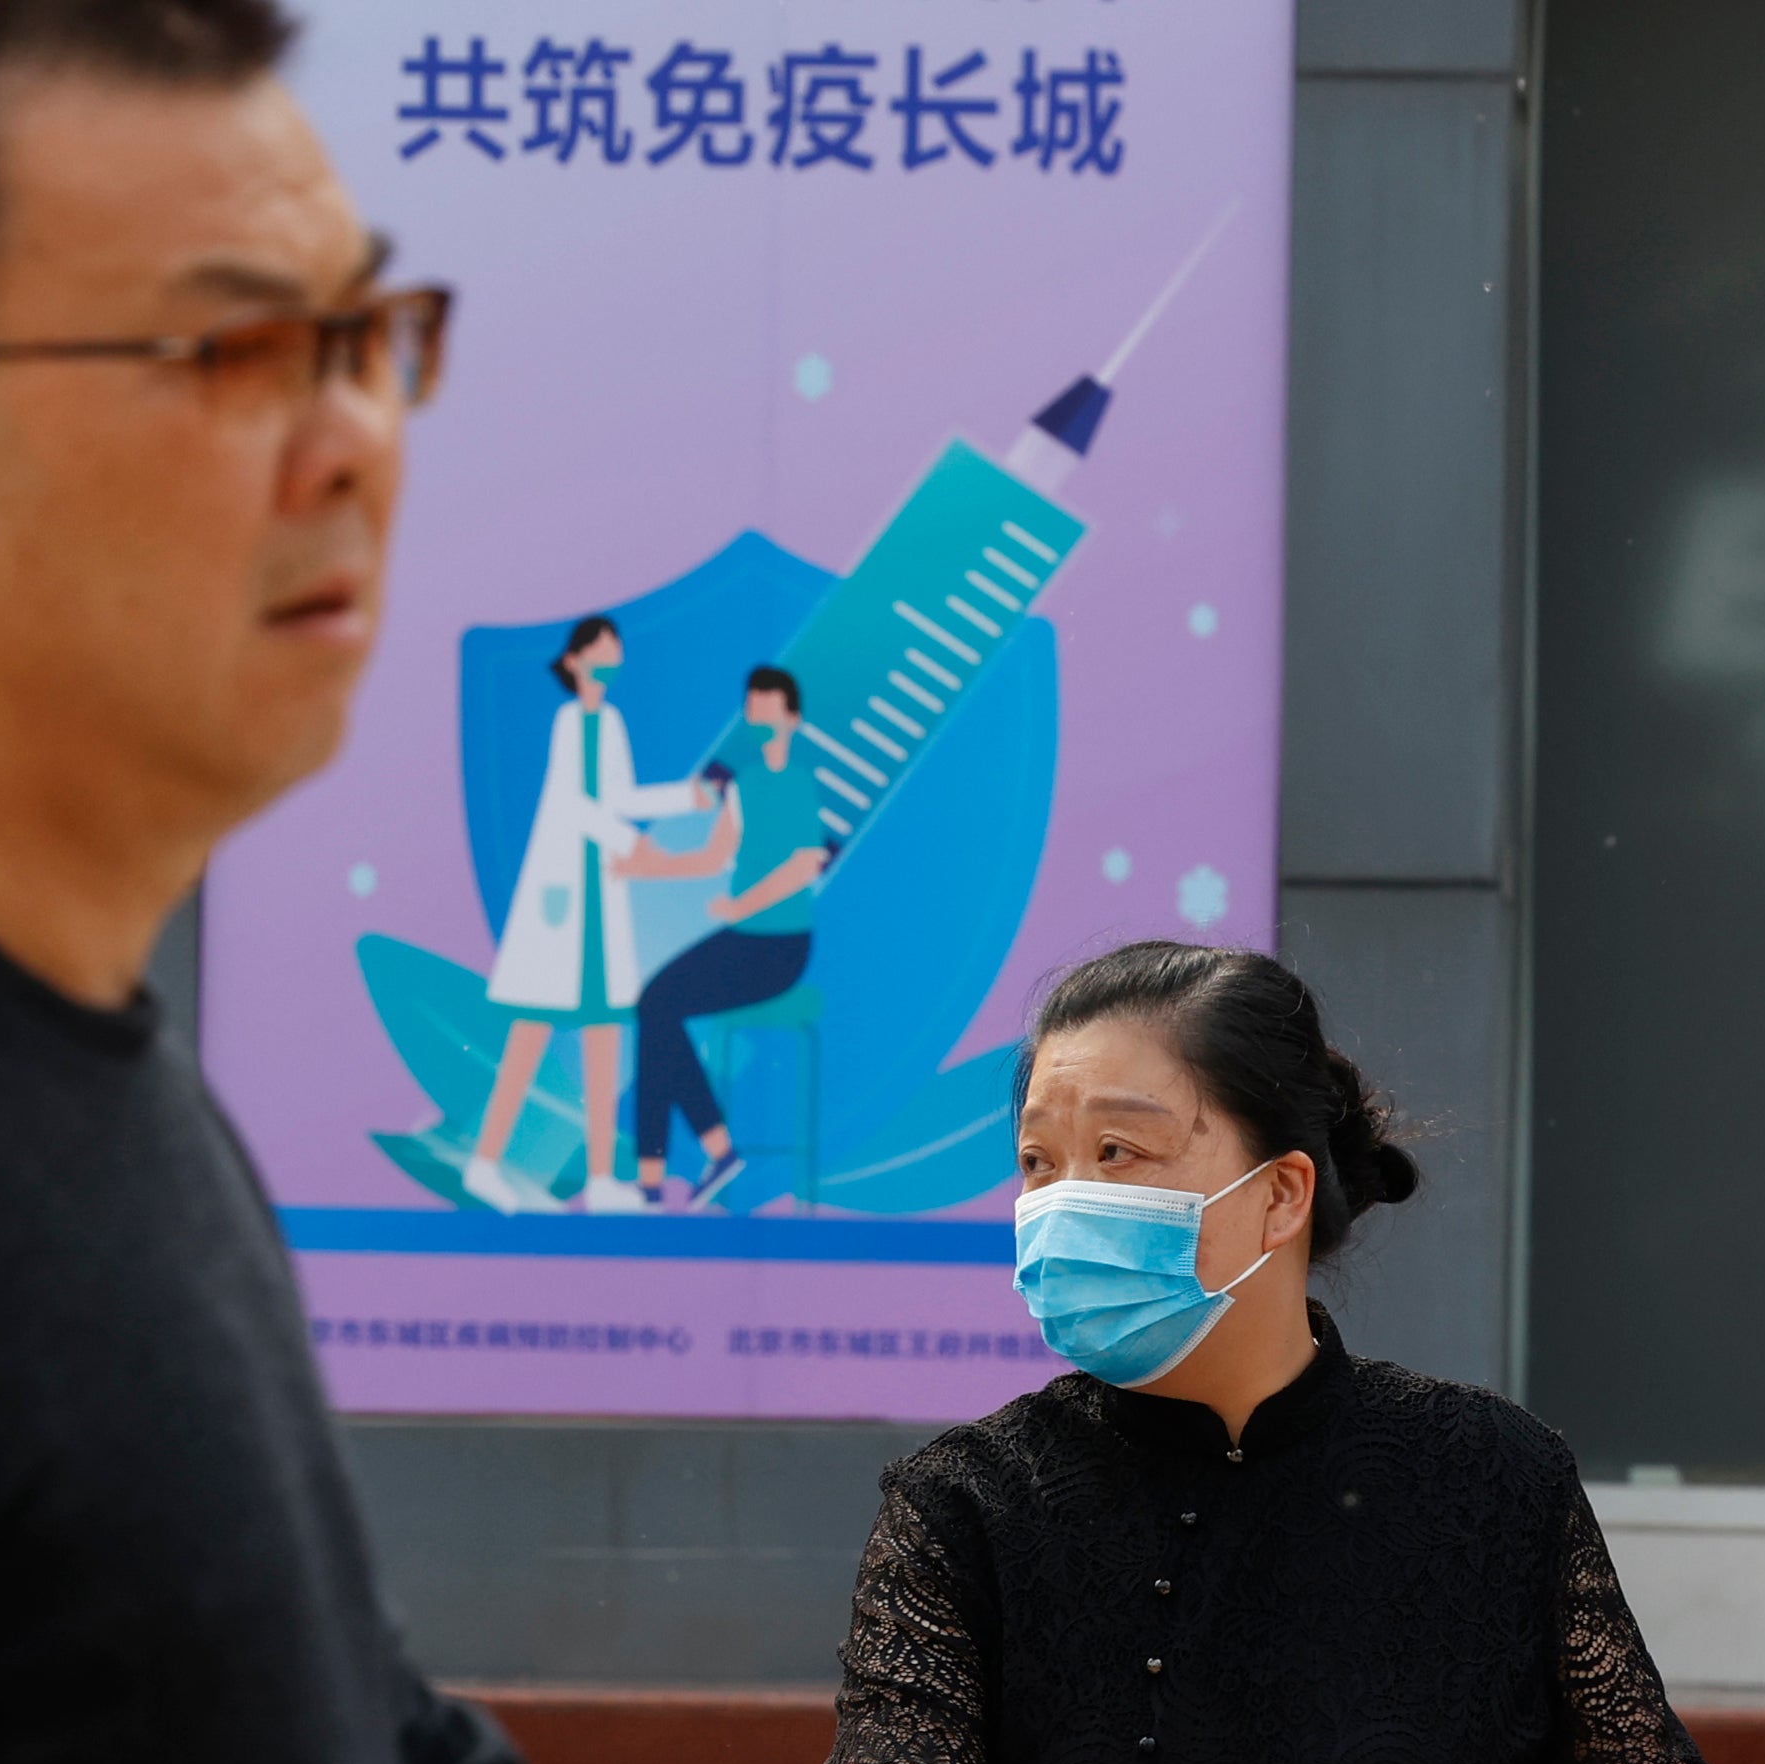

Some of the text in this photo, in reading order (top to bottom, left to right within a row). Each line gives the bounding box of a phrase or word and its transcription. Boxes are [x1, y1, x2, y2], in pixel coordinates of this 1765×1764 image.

[396, 36, 1125, 178] 共筑免疫长城
